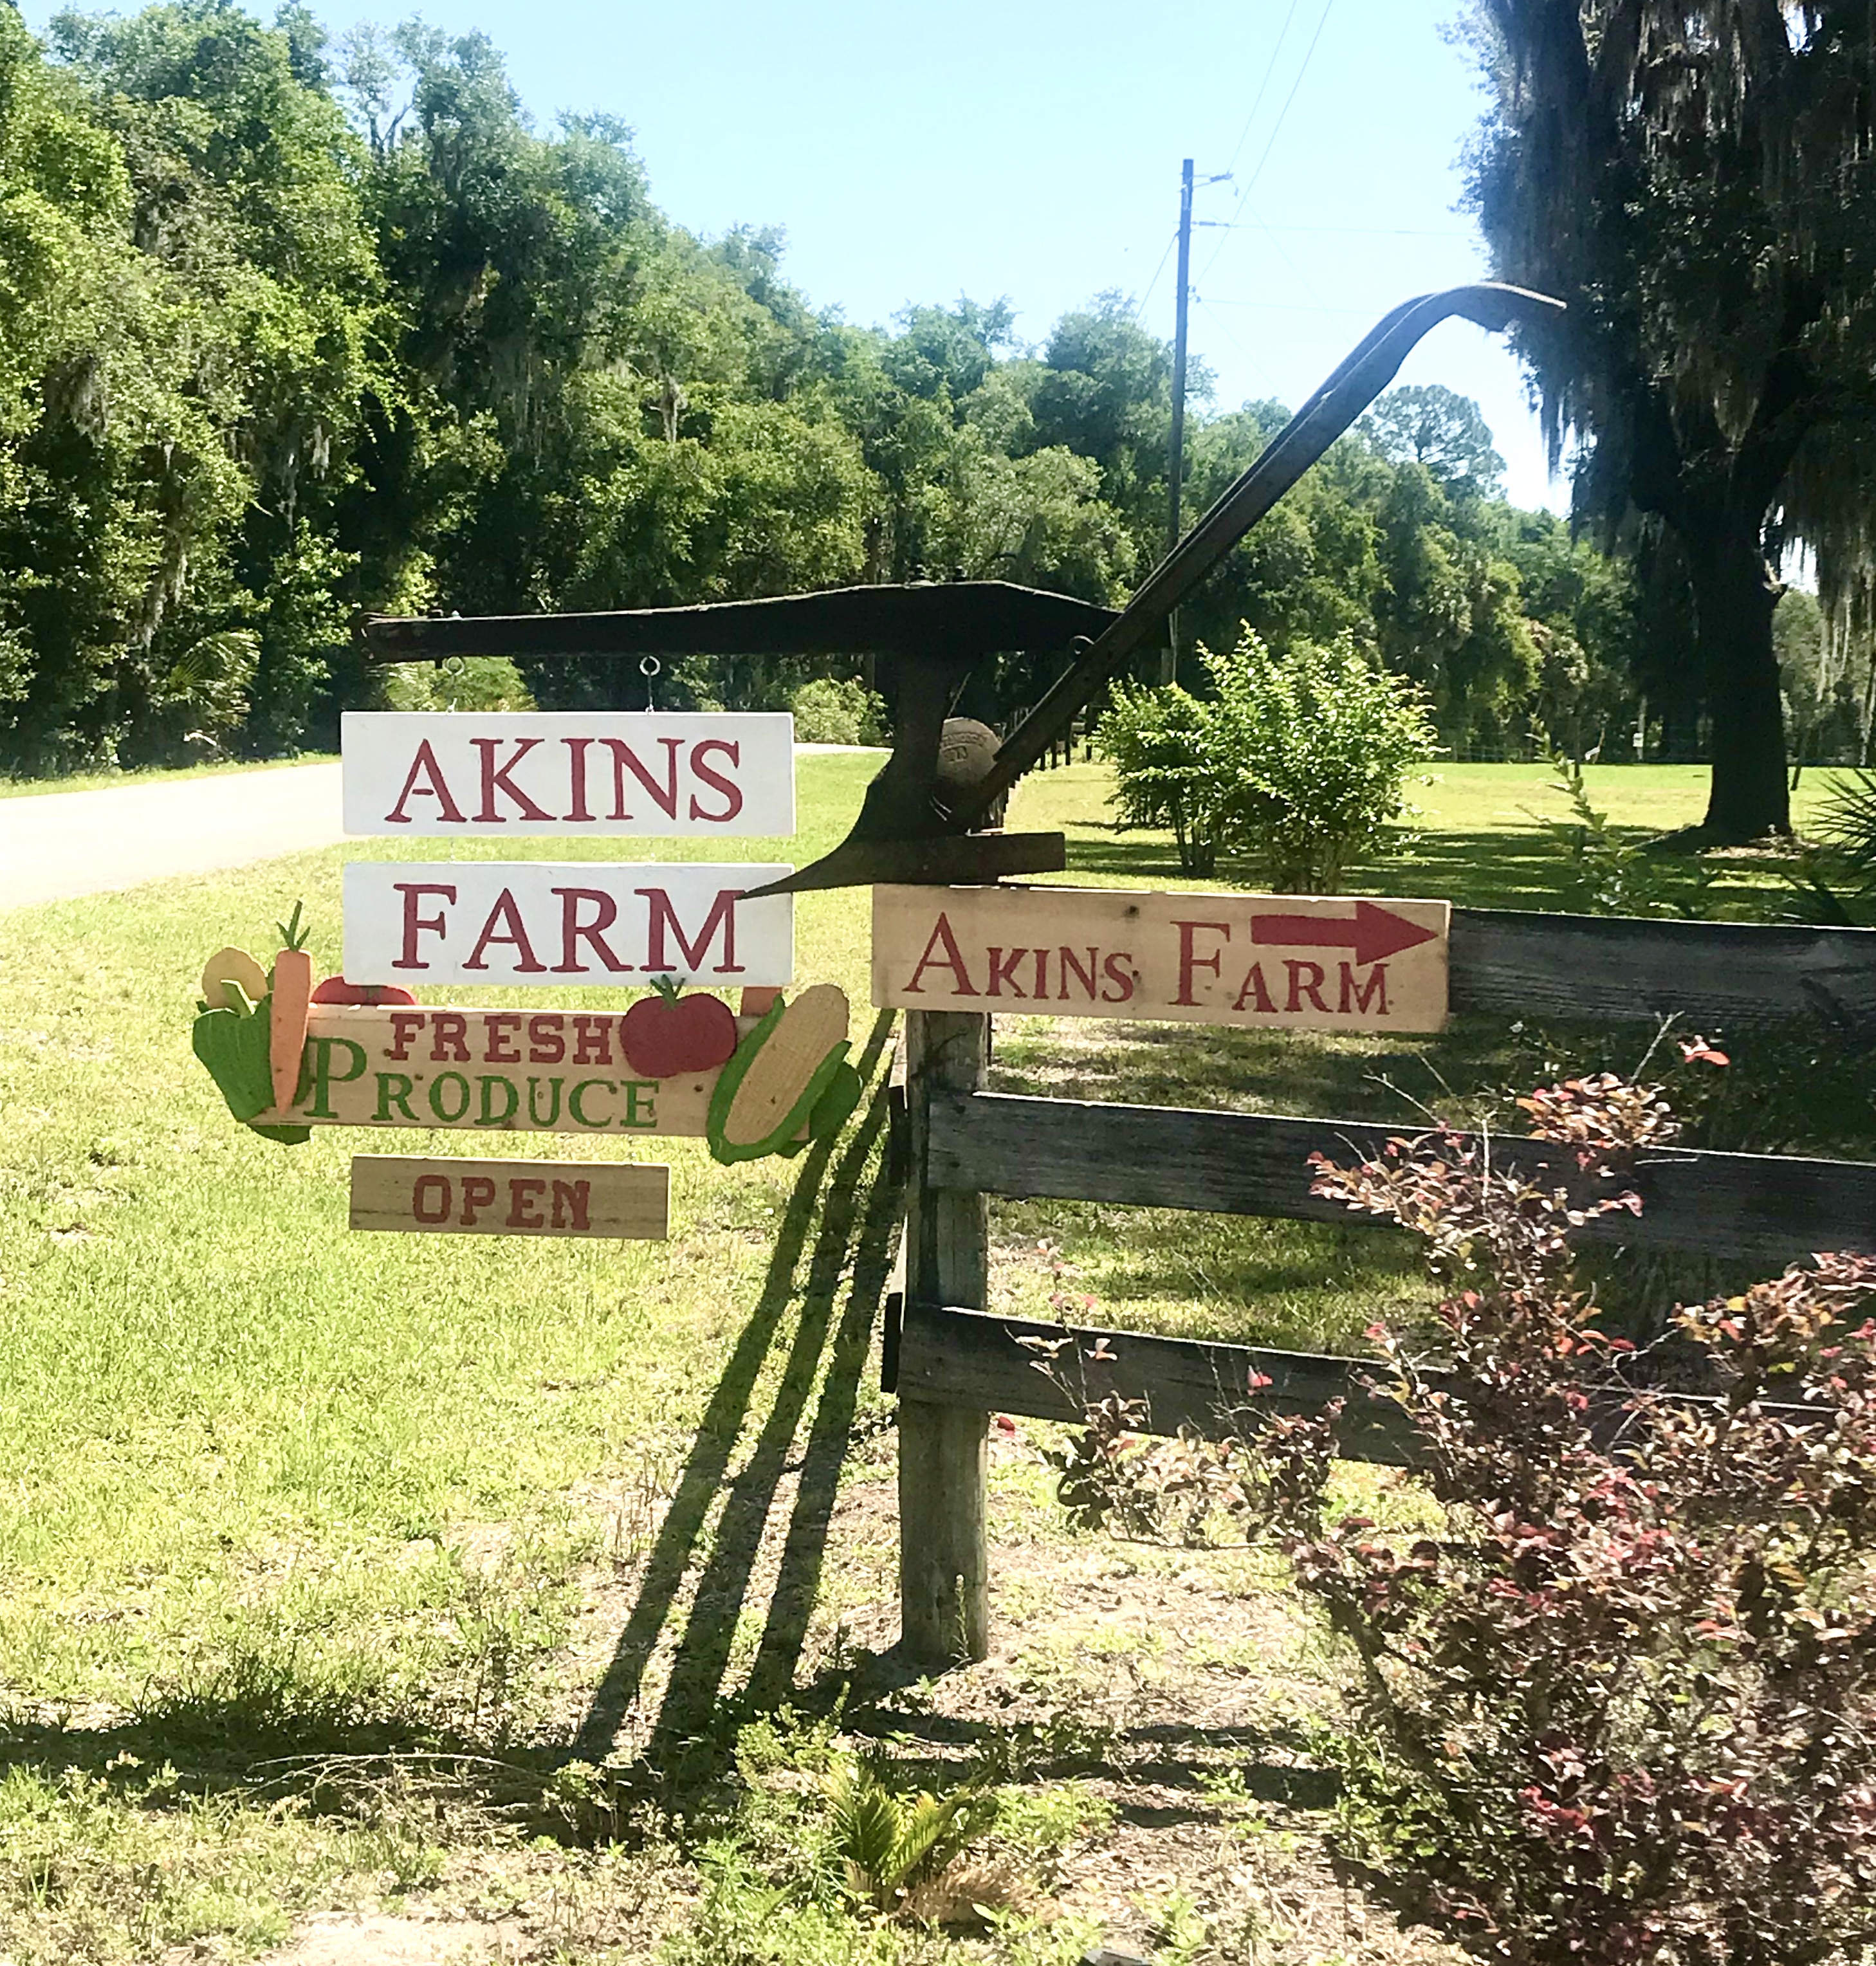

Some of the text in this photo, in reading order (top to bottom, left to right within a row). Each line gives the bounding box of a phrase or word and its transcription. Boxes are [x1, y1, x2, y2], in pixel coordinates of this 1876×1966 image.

[386, 738, 742, 823] AKINS
[392, 883, 746, 973] FARM
[902, 912, 1391, 1015] AKINS FARM
[302, 1036, 659, 1128] PRODUCE
[389, 1013, 613, 1065] FRESH
[412, 1174, 591, 1230] OPEN
